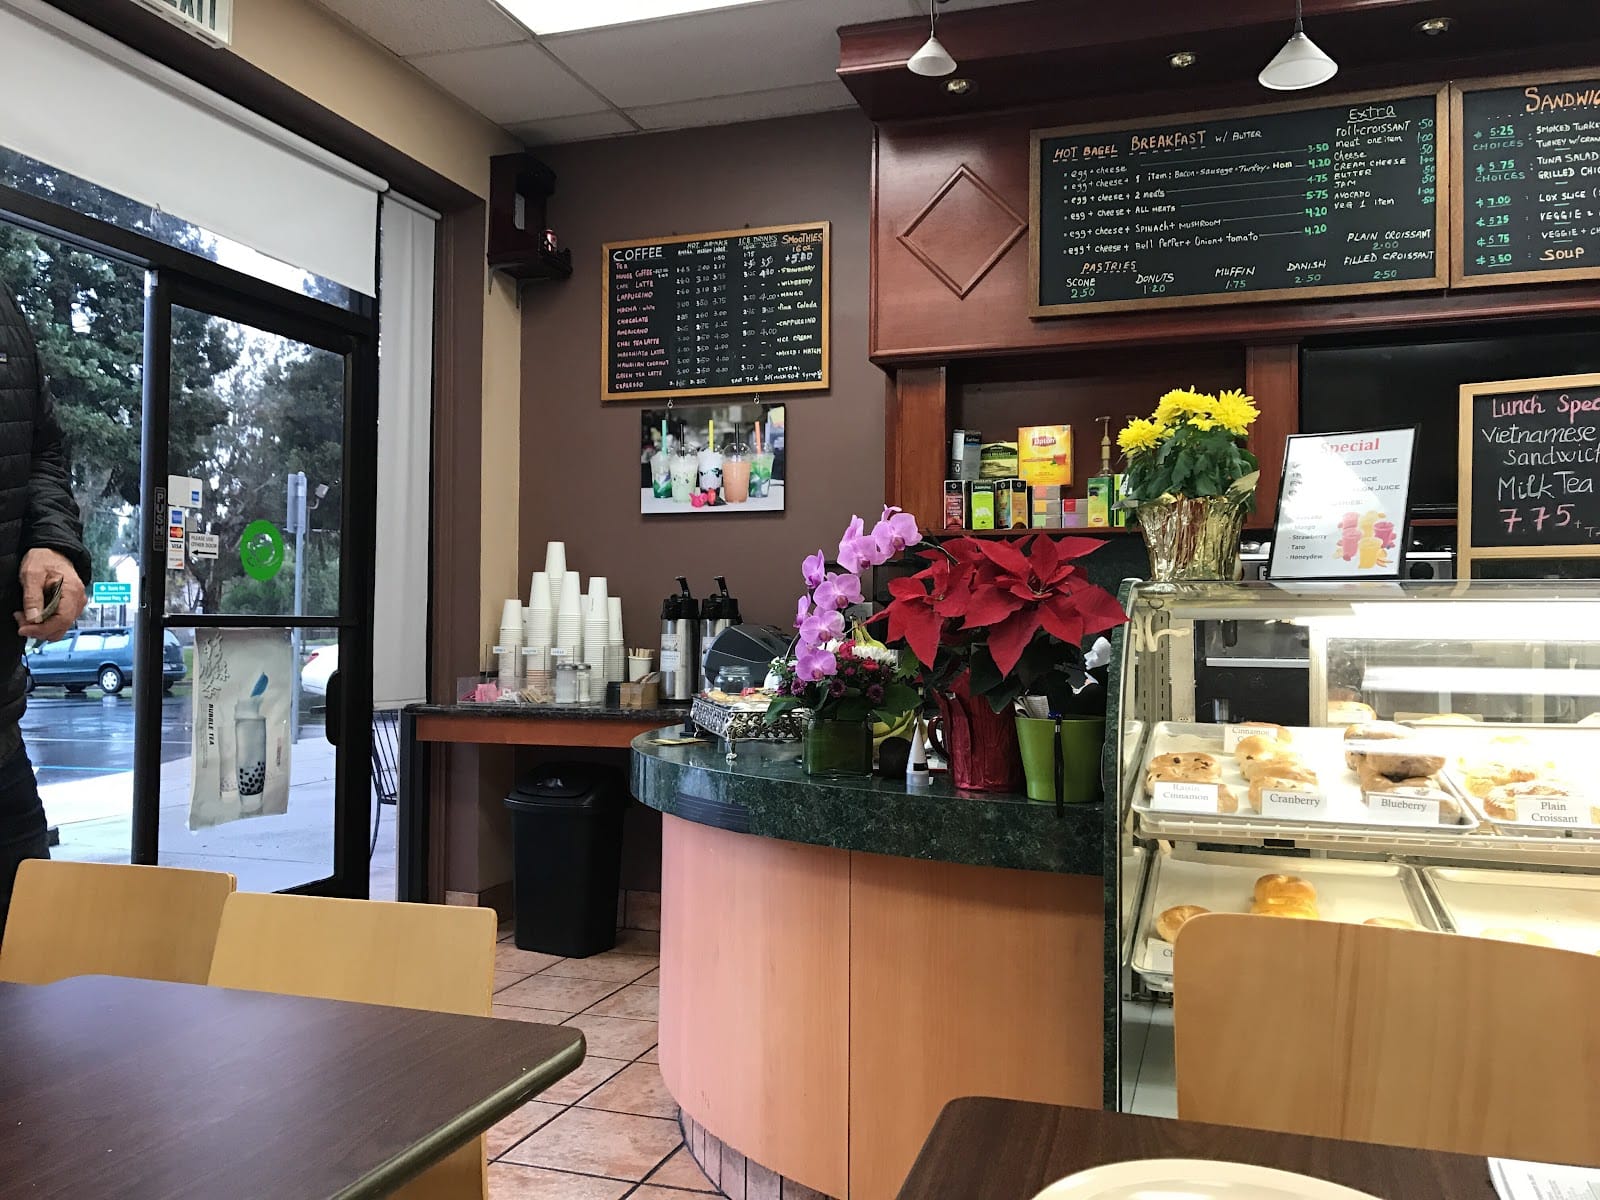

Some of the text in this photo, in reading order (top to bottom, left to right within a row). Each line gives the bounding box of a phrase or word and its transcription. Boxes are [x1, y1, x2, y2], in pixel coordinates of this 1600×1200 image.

[1349, 105, 1396, 120] Extra
[1536, 123, 1571, 135] SMOKED
[1055, 146, 1078, 159] HOT
[1083, 144, 1118, 156] BAGEL
[1131, 132, 1206, 150] BREAKFAST
[1335, 137, 1361, 148] meat
[1473, 137, 1567, 151] CHOICES TURKEY
[1070, 169, 1088, 182] egg
[1308, 143, 1330, 153] 3.50
[1334, 161, 1366, 171] CREAM
[1370, 157, 1407, 167] CHEESE
[1536, 151, 1599, 166] TUNA SALAD
[1071, 182, 1088, 193] egg
[1308, 157, 1331, 169] 4.20
[1334, 168, 1372, 180] BUTTER
[1475, 172, 1525, 182] CHOICES
[1537, 167, 1575, 180] GRILLED
[1334, 180, 1356, 189] JAM
[1071, 196, 1088, 205] egg
[1334, 190, 1371, 200] AVOCADO
[1539, 193, 1558, 203] LOX
[1561, 190, 1586, 201] SLICE
[1070, 211, 1086, 220] egg
[1135, 206, 1150, 214] ALL
[1305, 189, 1329, 200] 5.75
[1305, 207, 1328, 218] 4.20
[1540, 209, 1582, 222] VEGGIE
[1136, 239, 1153, 250] Bell
[1225, 231, 1259, 243] tomato
[1304, 224, 1327, 236] 4.20
[1347, 228, 1431, 242] PLAIN CROISSANT
[1541, 228, 1579, 239] VEGGIE
[613, 246, 663, 262] COFFEE
[781, 232, 823, 245] SMOOTHIES
[1539, 246, 1585, 261] SOUP
[1343, 250, 1435, 266] FILLED CROISSANT
[1066, 259, 1327, 288] SCONE DONUTS MUFFIN DANISH
[1081, 260, 1137, 273] PASTRIES
[1492, 394, 1546, 418] Lunch
[1481, 423, 1597, 444] Vietnamese
[1320, 438, 1380, 454] Special
[1364, 457, 1398, 465] COFFEE
[1374, 484, 1401, 492] JUICE
[1498, 470, 1593, 501] Milk Tea
[1499, 503, 1575, 533] 7.75
[1289, 553, 1323, 562] Honeydew
[1162, 791, 1210, 801] Cinnamon
[1269, 793, 1321, 808] Cranberry
[1381, 798, 1427, 812] Blueberry
[1540, 801, 1567, 811] Plain
[1531, 812, 1578, 823] Croissant
